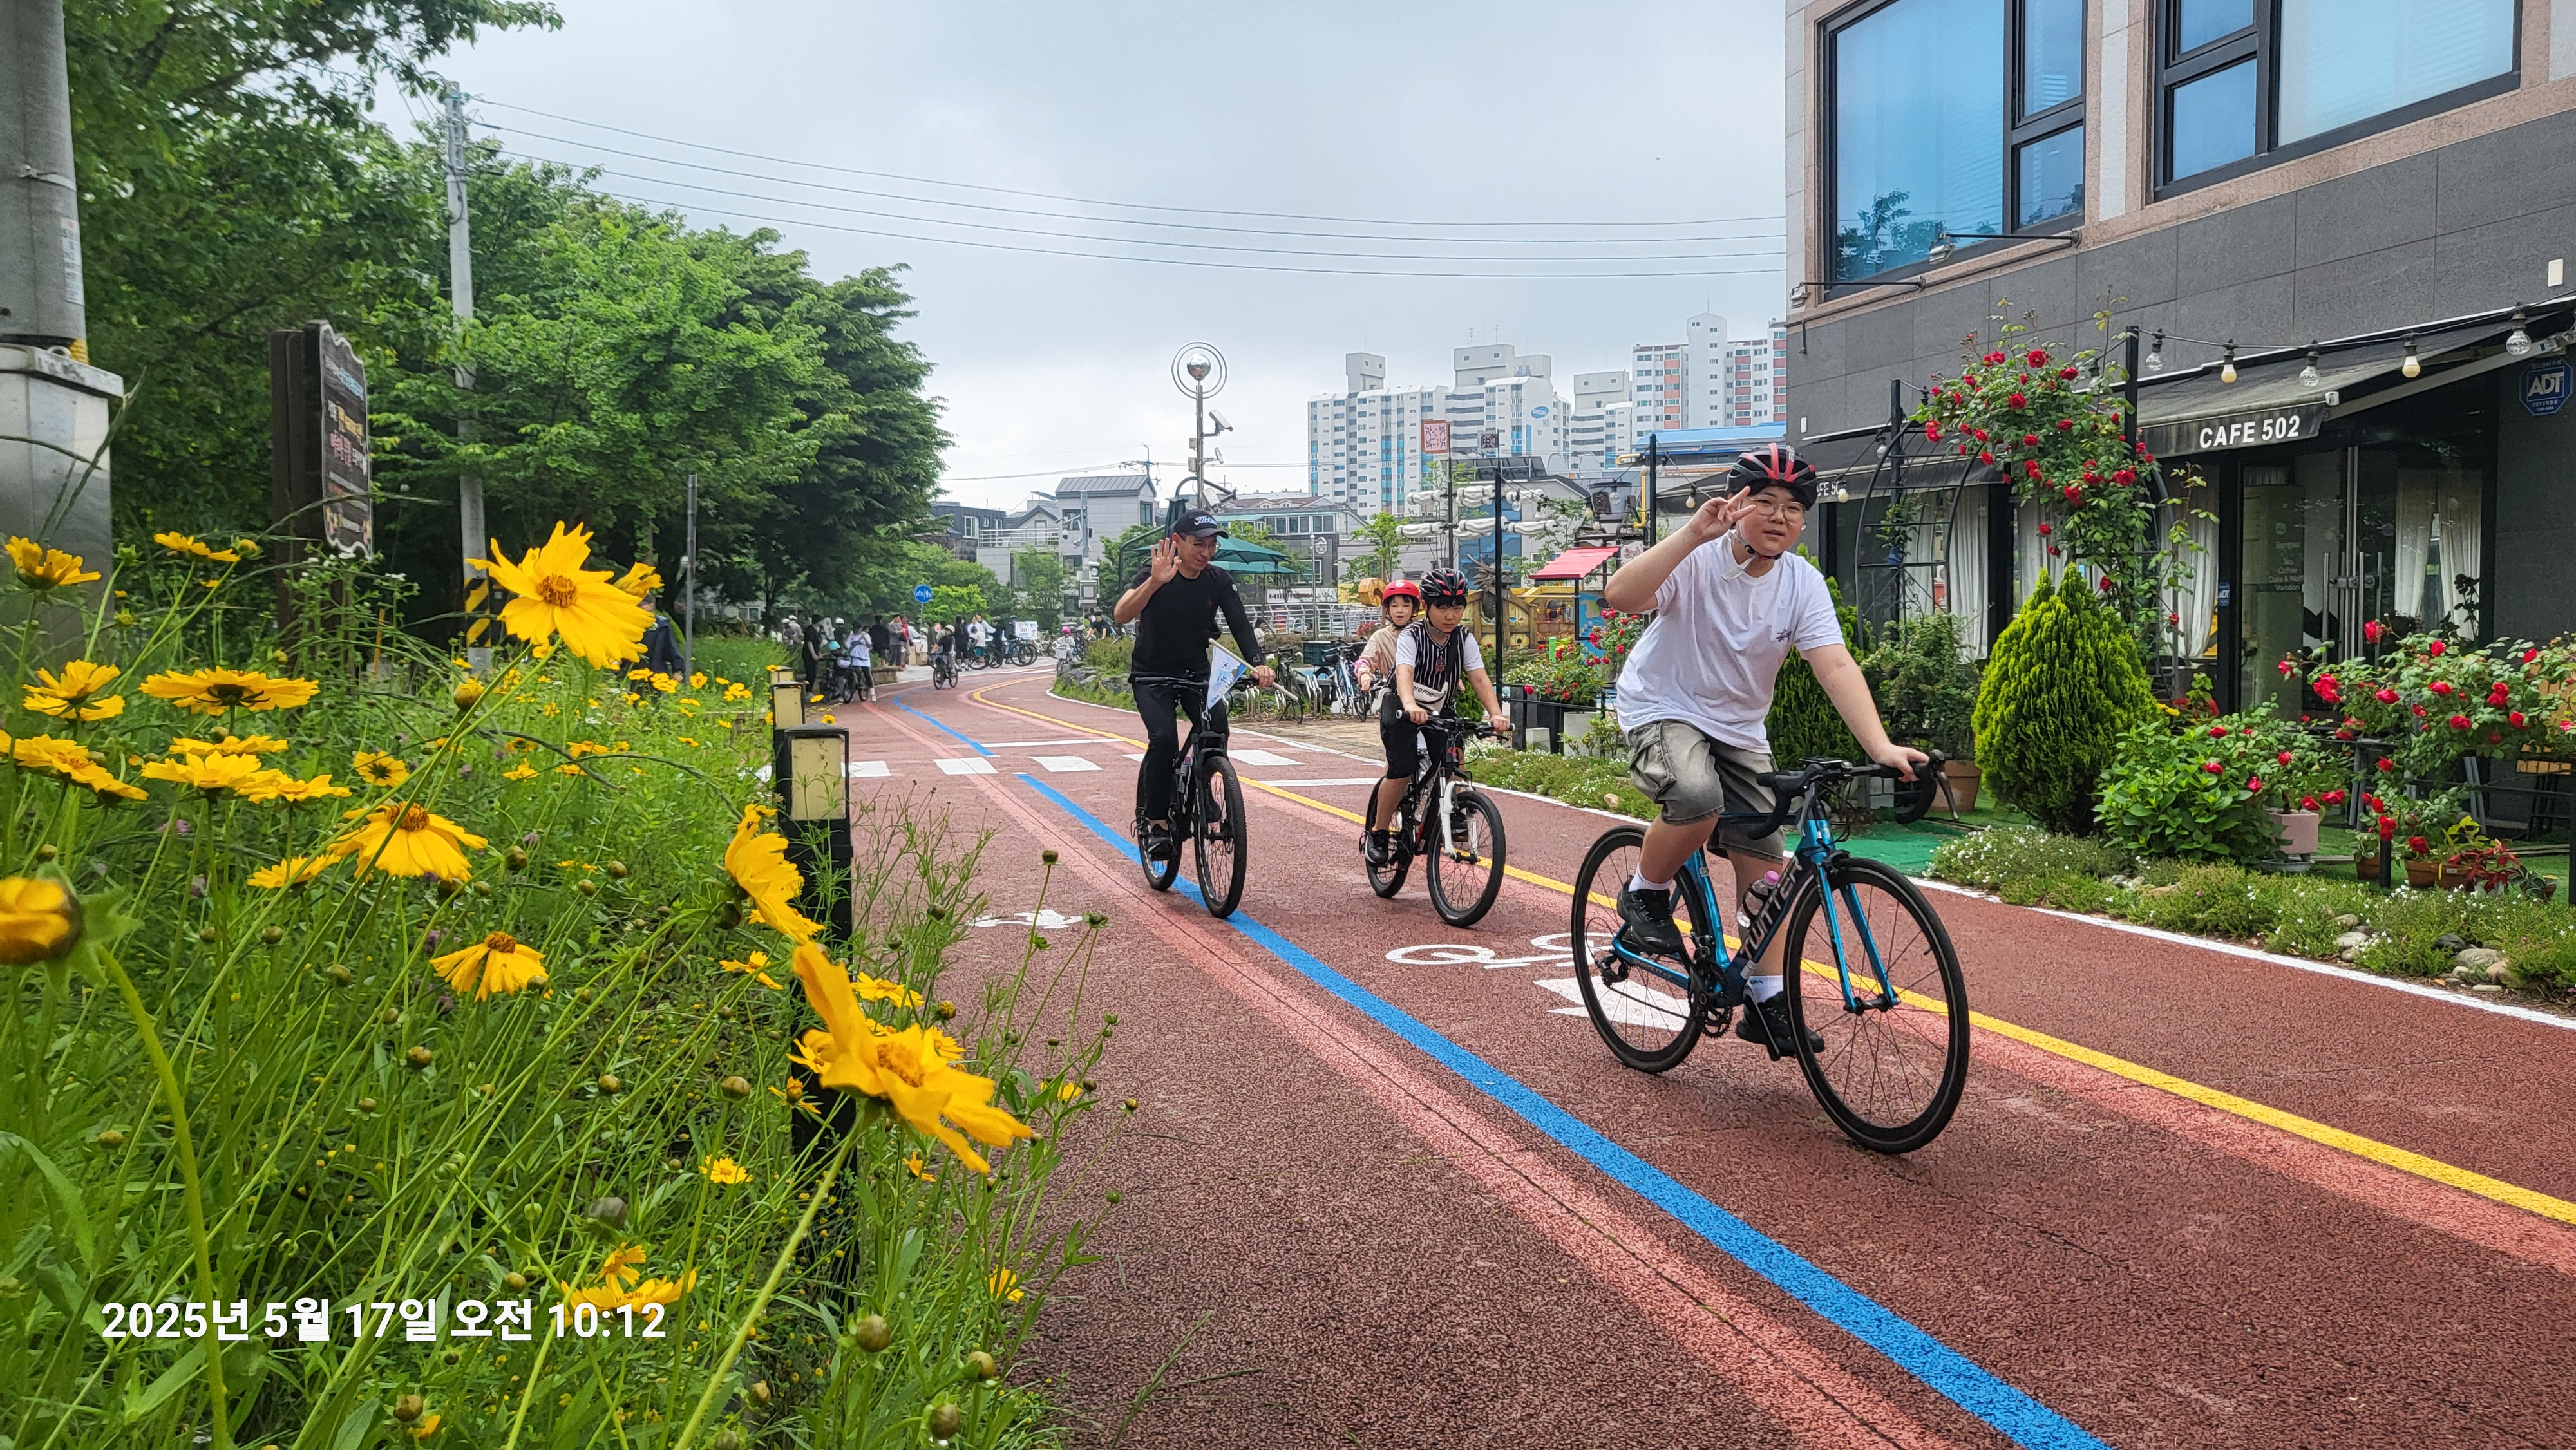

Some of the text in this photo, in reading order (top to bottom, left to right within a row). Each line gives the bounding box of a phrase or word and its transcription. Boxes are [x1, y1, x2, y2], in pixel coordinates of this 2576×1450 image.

[2527, 372, 2564, 397] ADT
[2199, 415, 2300, 449] CAFE 502
[2219, 590, 2230, 598] ADT
